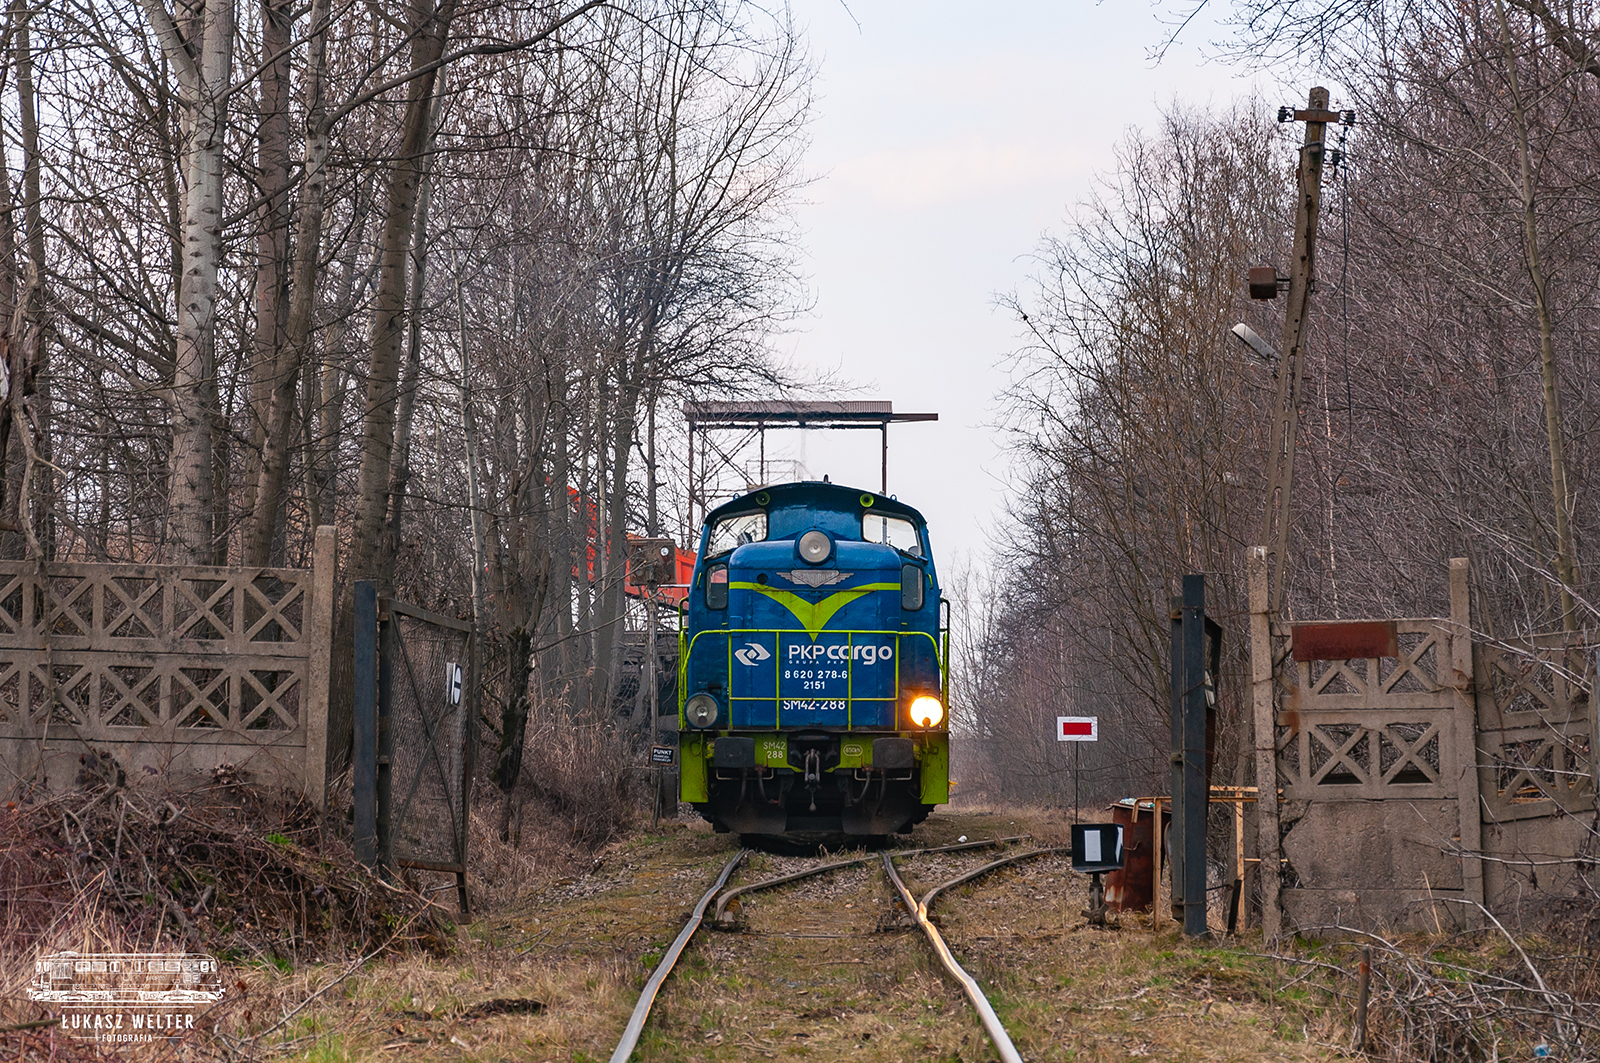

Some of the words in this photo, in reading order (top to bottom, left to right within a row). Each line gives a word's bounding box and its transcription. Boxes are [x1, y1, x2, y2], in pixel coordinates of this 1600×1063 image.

[817, 670, 848, 679] 278-6
[803, 681, 825, 690] 2151
[783, 700, 846, 710] SM42-288
[763, 741, 786, 750] SM42
[653, 748, 672, 756] PUNKT
[767, 750, 784, 759] 288
